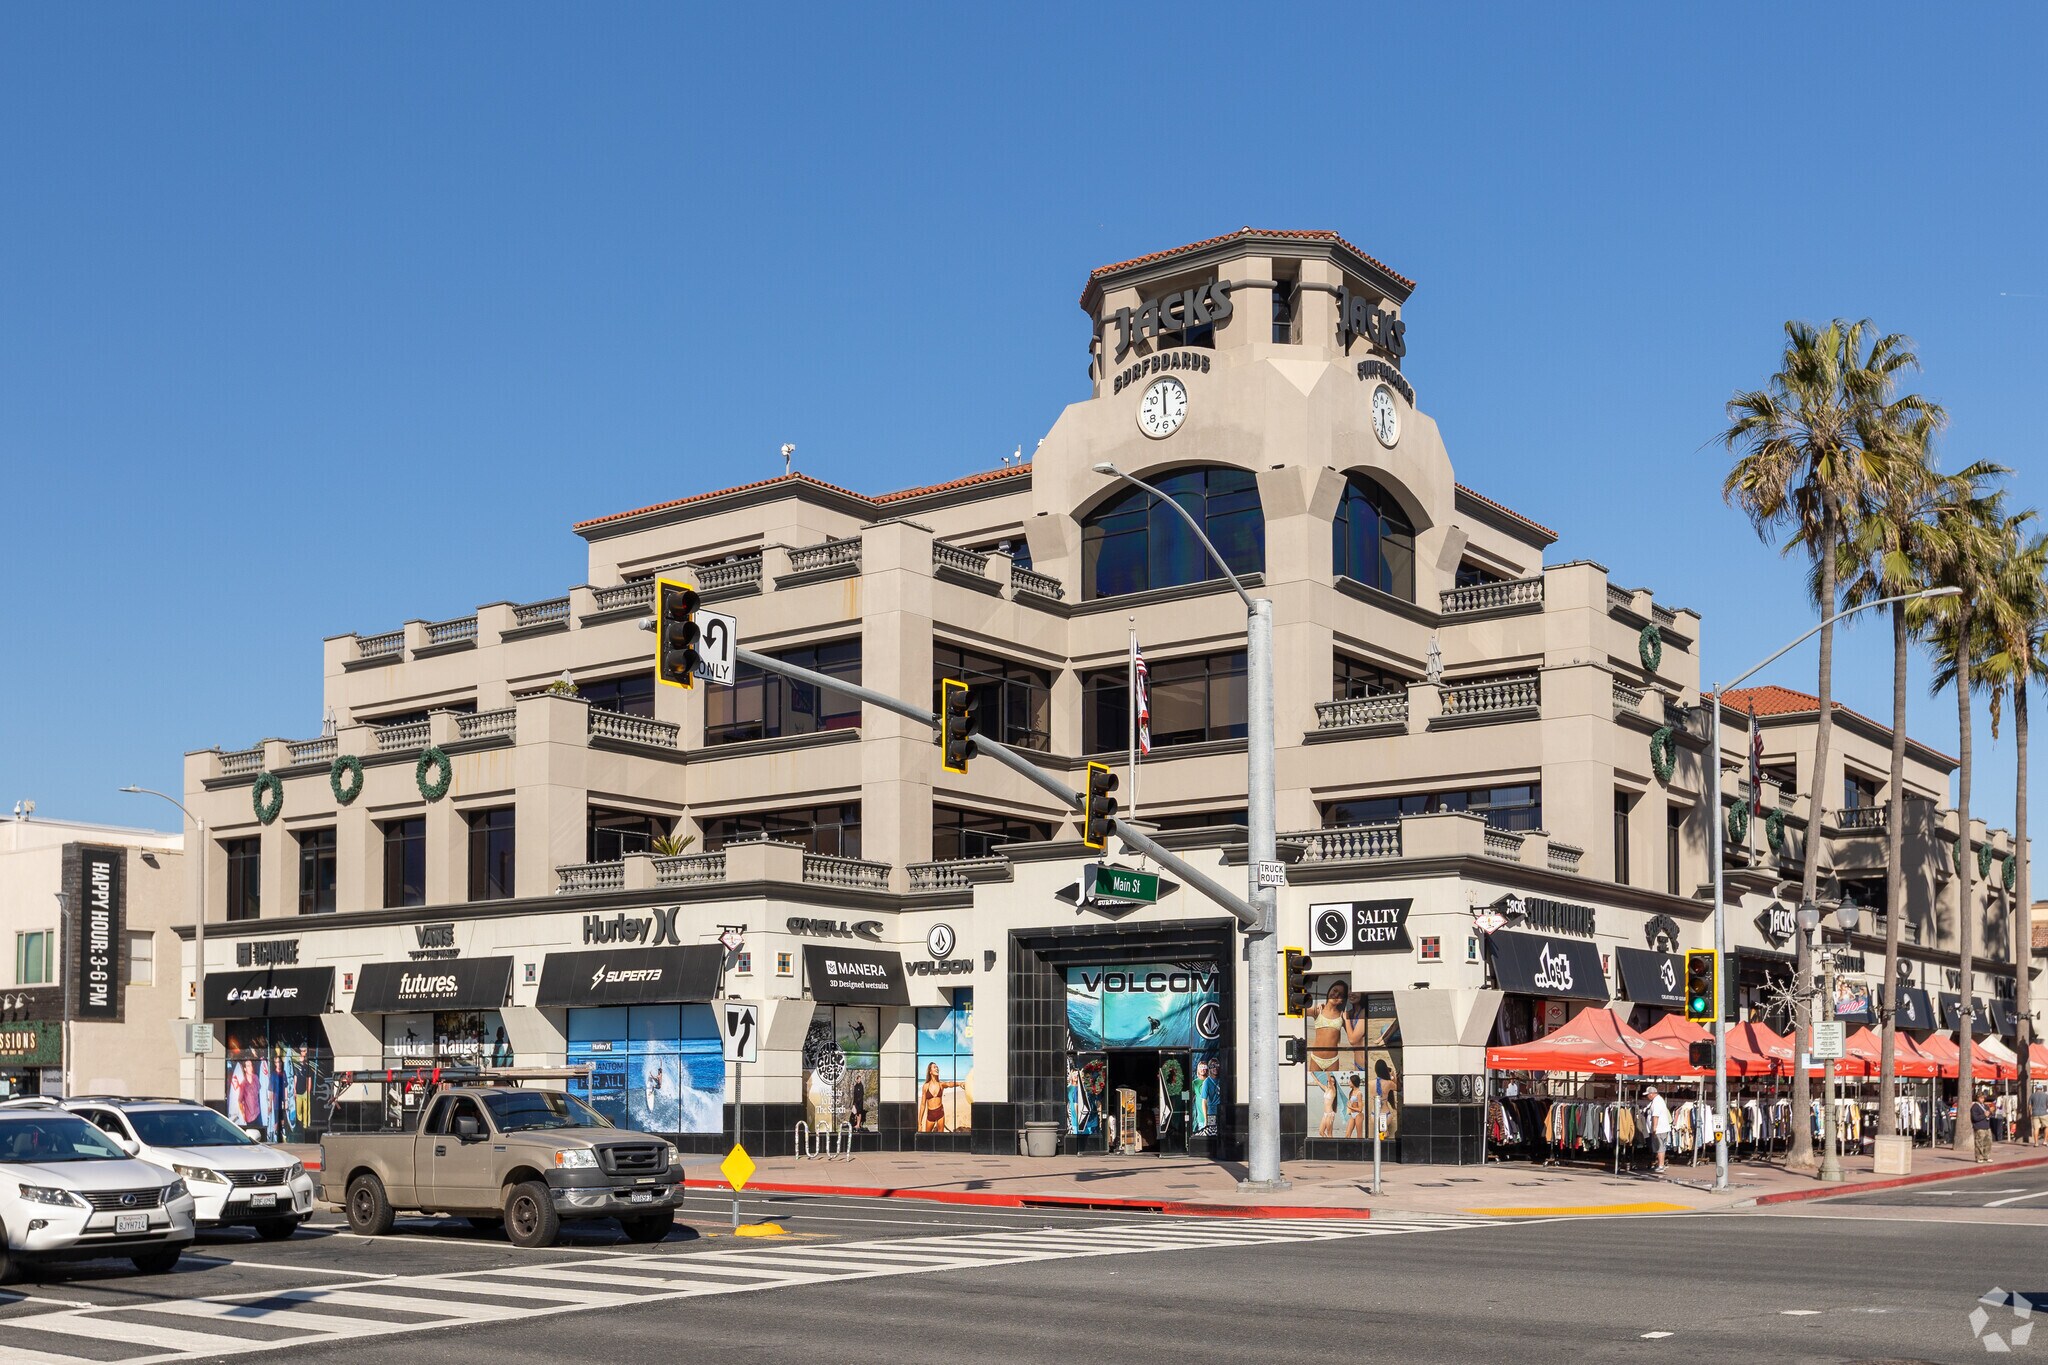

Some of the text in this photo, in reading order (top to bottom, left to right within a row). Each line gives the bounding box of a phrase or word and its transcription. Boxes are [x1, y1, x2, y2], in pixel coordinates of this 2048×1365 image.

[1115, 277, 1233, 357] JACK'S
[1336, 285, 1406, 357] JACK'S
[1114, 352, 1211, 395] SURFBOARDS
[1162, 420, 1169, 429] 6
[698, 660, 730, 680] ONLY
[1261, 864, 1283, 873] TRUCK
[1113, 876, 1140, 893] Main St
[1261, 874, 1283, 882] ROUTE
[1357, 908, 1400, 925] SALTY
[89, 861, 110, 1006] HAPPY HOUR: 3-6 PM
[415, 923, 455, 949] VANS
[583, 913, 652, 944] Hurley
[1357, 926, 1398, 942] CREW
[605, 968, 662, 983] SUPER73
[838, 962, 887, 976] MANERA
[400, 972, 458, 993] futures.
[829, 979, 889, 990] 3D Designed wetsuits
[1081, 972, 1220, 993] VOLCOM
[394, 1036, 478, 1058] Ultra Range
[605, 1075, 624, 1087] ALL
[119, 1221, 145, 1230] 8JYH714
